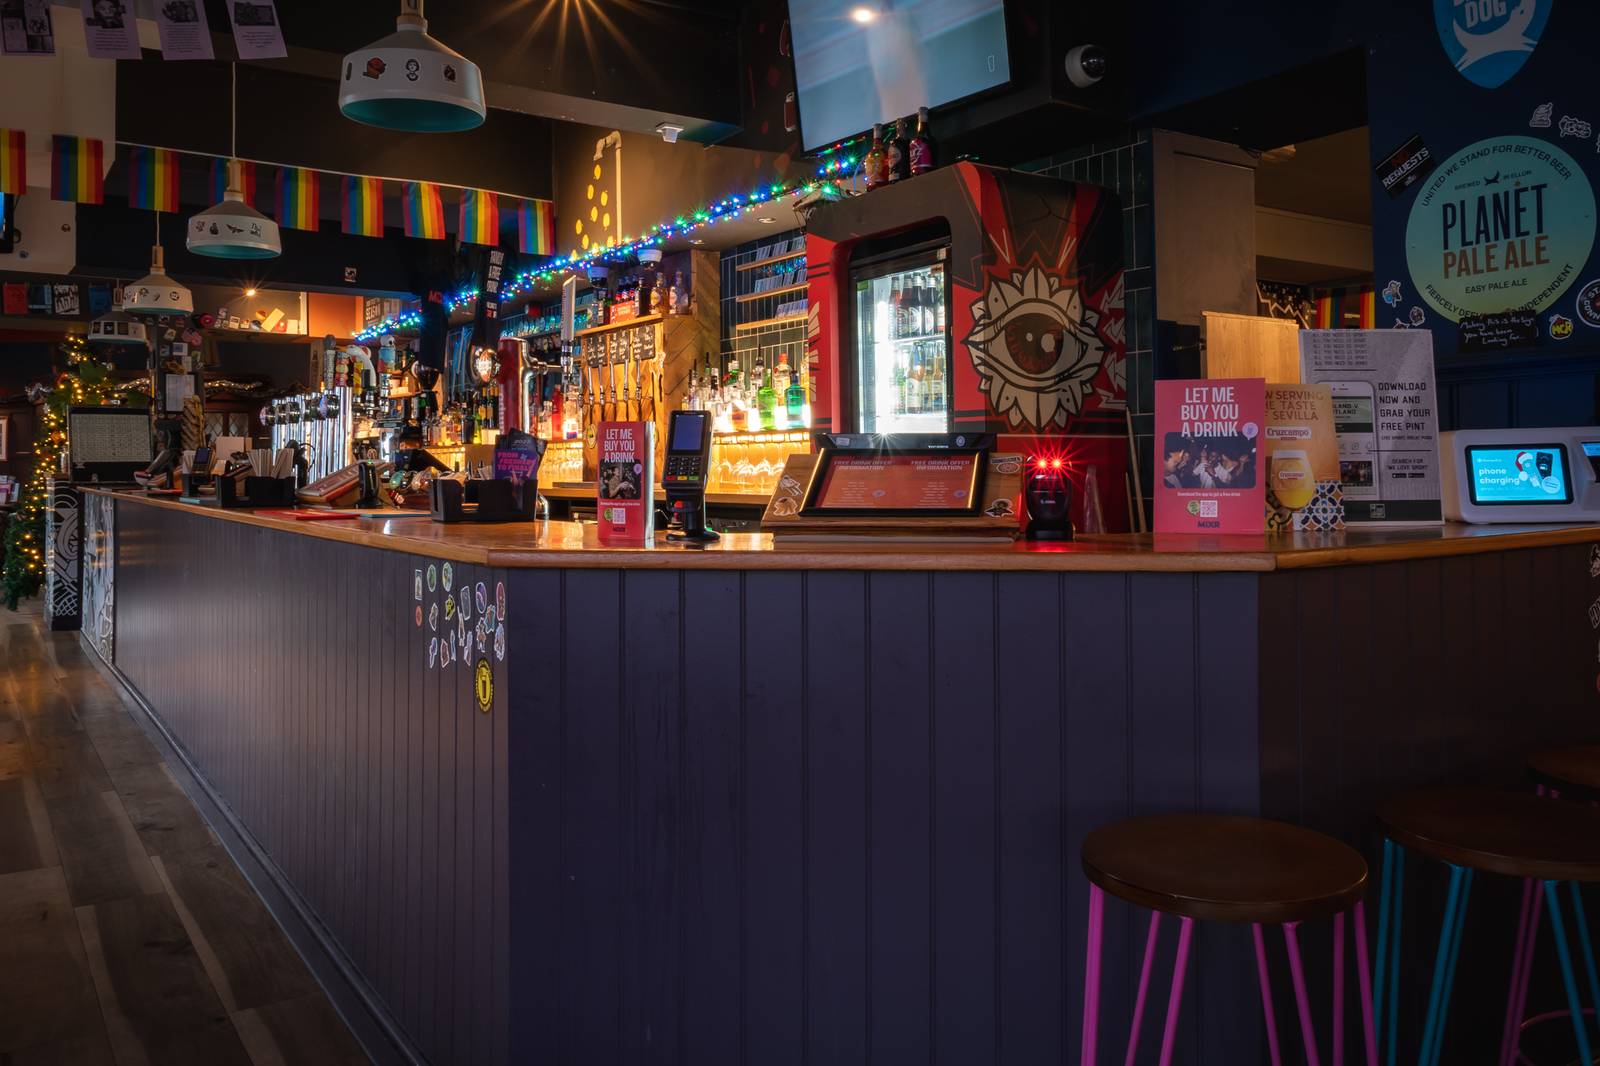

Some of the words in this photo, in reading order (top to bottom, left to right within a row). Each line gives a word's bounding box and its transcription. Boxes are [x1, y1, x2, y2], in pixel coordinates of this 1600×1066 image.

[1464, 0, 1507, 29] DOG
[1381, 146, 1430, 189] REQUESTS
[1421, 174, 1446, 207] UNITED
[1445, 163, 1459, 178] WE
[1459, 147, 1491, 167] STAND
[1491, 143, 1513, 154] FOR
[1514, 143, 1552, 164] BETTER
[1549, 157, 1573, 181] BEER
[1442, 183, 1548, 250] PLANET
[1443, 244, 1500, 279] PALE
[1504, 235, 1550, 270] ALE
[1465, 284, 1487, 295] EASY
[1487, 281, 1510, 292] PALE
[1511, 278, 1528, 289] ALE
[1426, 284, 1459, 313] FIERCELY
[1378, 382, 1426, 391] DOWNLOAD
[1185, 388, 1208, 403] LET
[1212, 387, 1235, 403] ME
[1276, 391, 1324, 401] SERVING
[1379, 395, 1399, 404] NOW
[1402, 395, 1421, 404] AND
[1280, 400, 1317, 410] TASTE
[1181, 404, 1208, 421] BUY
[1211, 404, 1239, 421] YOU
[1272, 410, 1319, 421] SEVILLA
[1380, 408, 1404, 418] GRAB
[1407, 408, 1431, 418] YOUR
[1181, 422, 1191, 438] A
[1194, 422, 1239, 438] DRINK
[1267, 427, 1310, 437] Cruzcampo
[1381, 422, 1402, 431] FREE
[1405, 422, 1425, 431] PINT
[606, 428, 618, 440] LET
[620, 428, 633, 440] ME
[604, 440, 618, 452] BUY
[620, 440, 636, 452] YOU
[604, 452, 610, 463] A
[610, 452, 636, 463] DRINK
[1479, 468, 1507, 478] phone
[1480, 477, 1521, 487] charging
